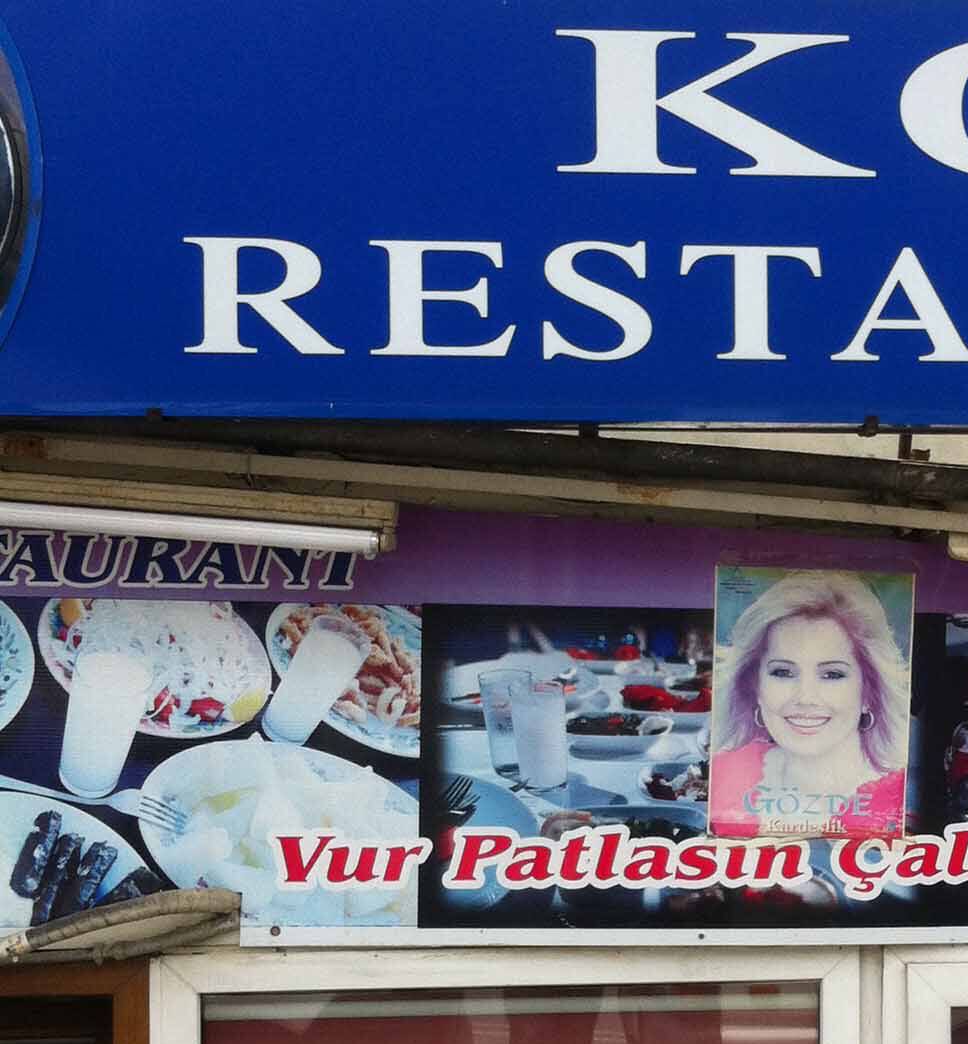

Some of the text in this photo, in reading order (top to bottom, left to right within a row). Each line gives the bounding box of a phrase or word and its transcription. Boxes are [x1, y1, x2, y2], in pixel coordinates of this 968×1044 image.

[0, 531, 374, 591] AURANT
[744, 785, 873, 817] GÖZDE
[275, 835, 423, 883] Vur
[450, 832, 806, 883] Patlasın
